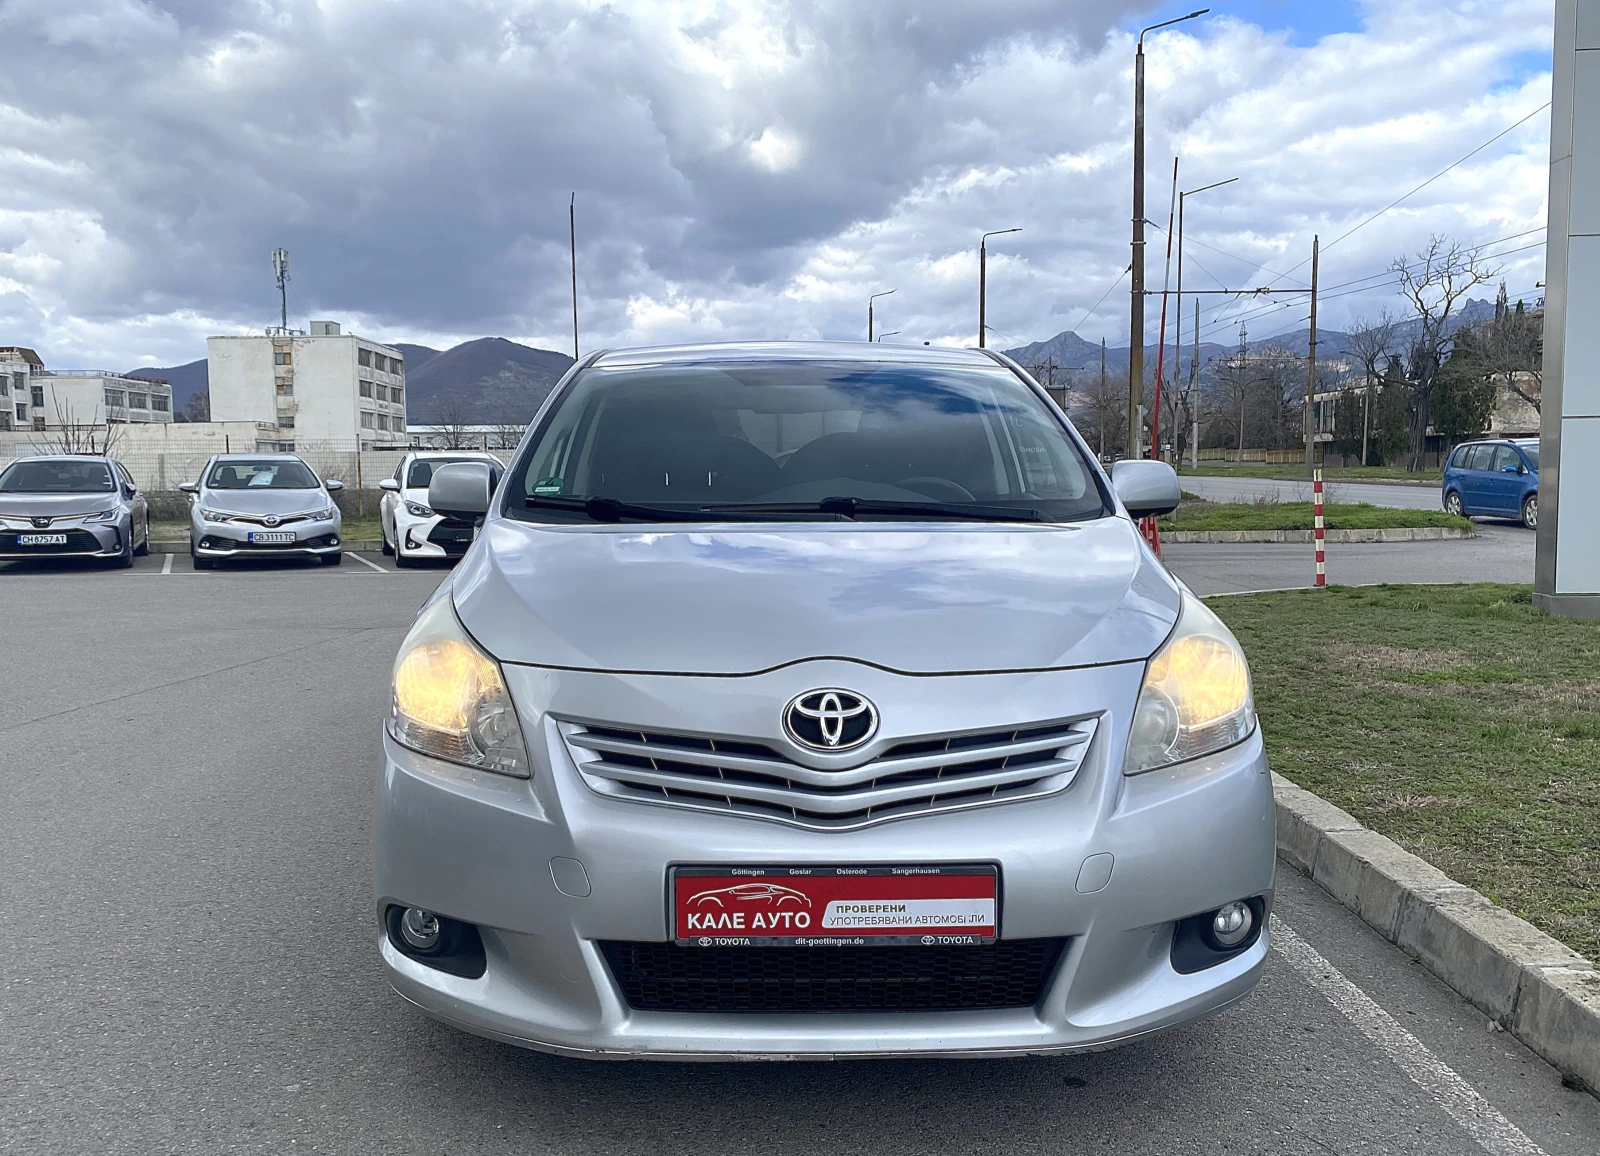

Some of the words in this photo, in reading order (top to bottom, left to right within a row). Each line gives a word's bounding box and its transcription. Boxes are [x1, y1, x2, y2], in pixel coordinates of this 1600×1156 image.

[22, 535, 33, 543] CH
[34, 535, 53, 543] 8757
[55, 535, 65, 543] AT
[254, 533, 264, 541] CB
[265, 533, 282, 541] 3111
[284, 533, 294, 541] TC
[731, 868, 765, 877] Göttingen
[891, 867, 941, 876] Sangerhausen
[836, 904, 907, 914] ПРОВЕРЕНИ
[687, 912, 746, 929] КАЛЕ
[829, 915, 913, 926] УПОТРЕБЯВАНИ
[714, 937, 751, 946] TOYOTA
[795, 937, 865, 946] dit-goettingen.de
[936, 936, 974, 945] TOYOTA
